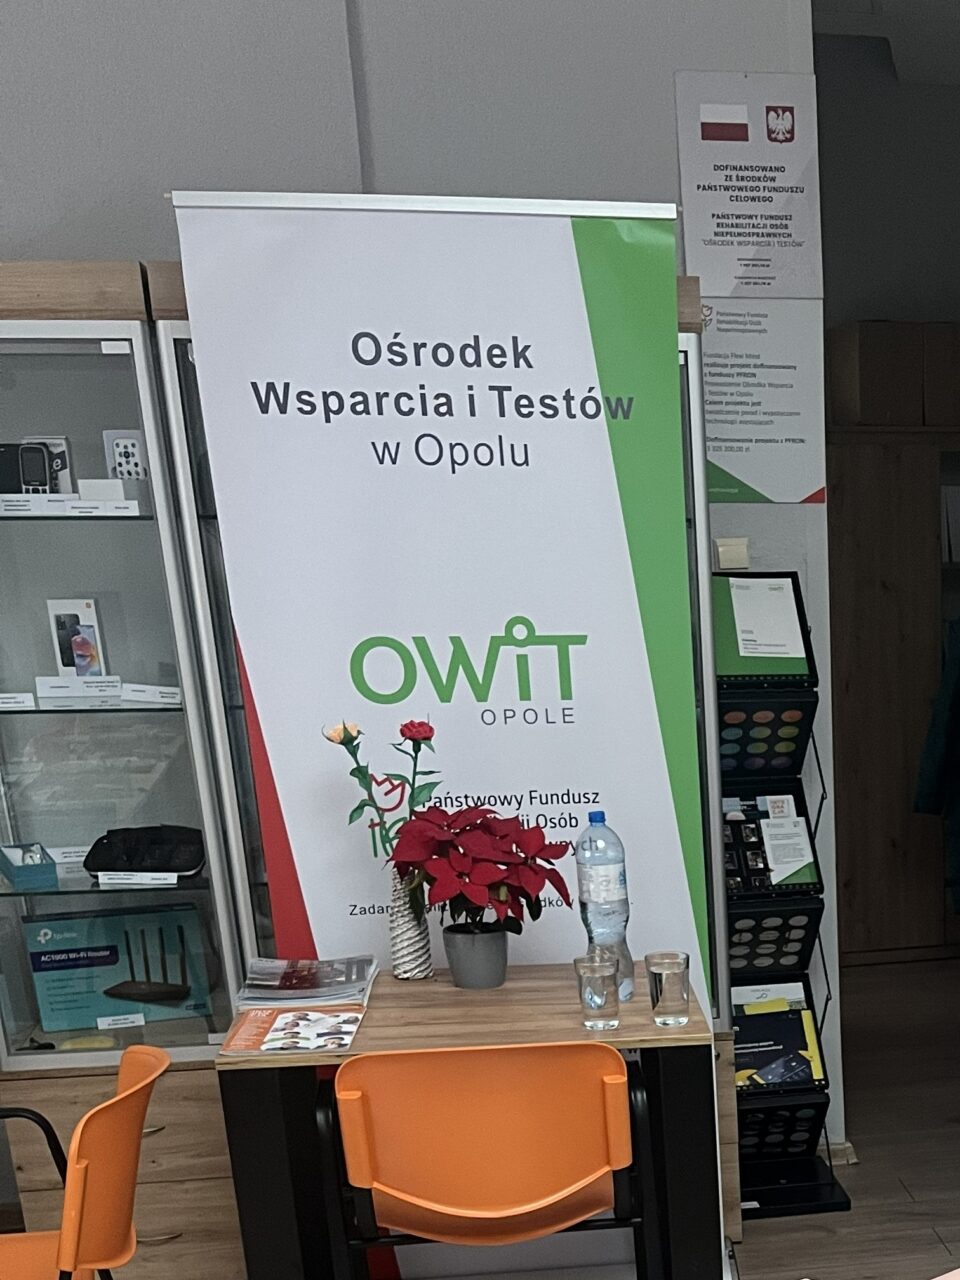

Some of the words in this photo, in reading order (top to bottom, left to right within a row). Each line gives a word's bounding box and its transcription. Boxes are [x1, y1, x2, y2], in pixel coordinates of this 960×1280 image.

[713, 164, 786, 173] DOFINANSOWANO
[724, 174, 734, 182] ZE
[735, 173, 777, 183] ŚRODKÓW
[696, 183, 761, 193] PAŃSTWOWEGO
[762, 185, 805, 194] FUNDUSZU
[729, 195, 774, 203] CELOWEGO
[711, 212, 759, 221] PAŃSTWOWY
[760, 214, 793, 222] FUNDUSZ
[351, 331, 533, 369] Ośrodek
[250, 381, 454, 424] Wsparcia
[467, 385, 476, 419] i
[488, 385, 635, 421] Testów
[371, 440, 401, 466] w
[414, 433, 531, 474] Opolu
[480, 707, 576, 726] OPOLE
[528, 788, 600, 806] Fundusz
[535, 812, 579, 829] Osób
[349, 904, 391, 916] Zadan
